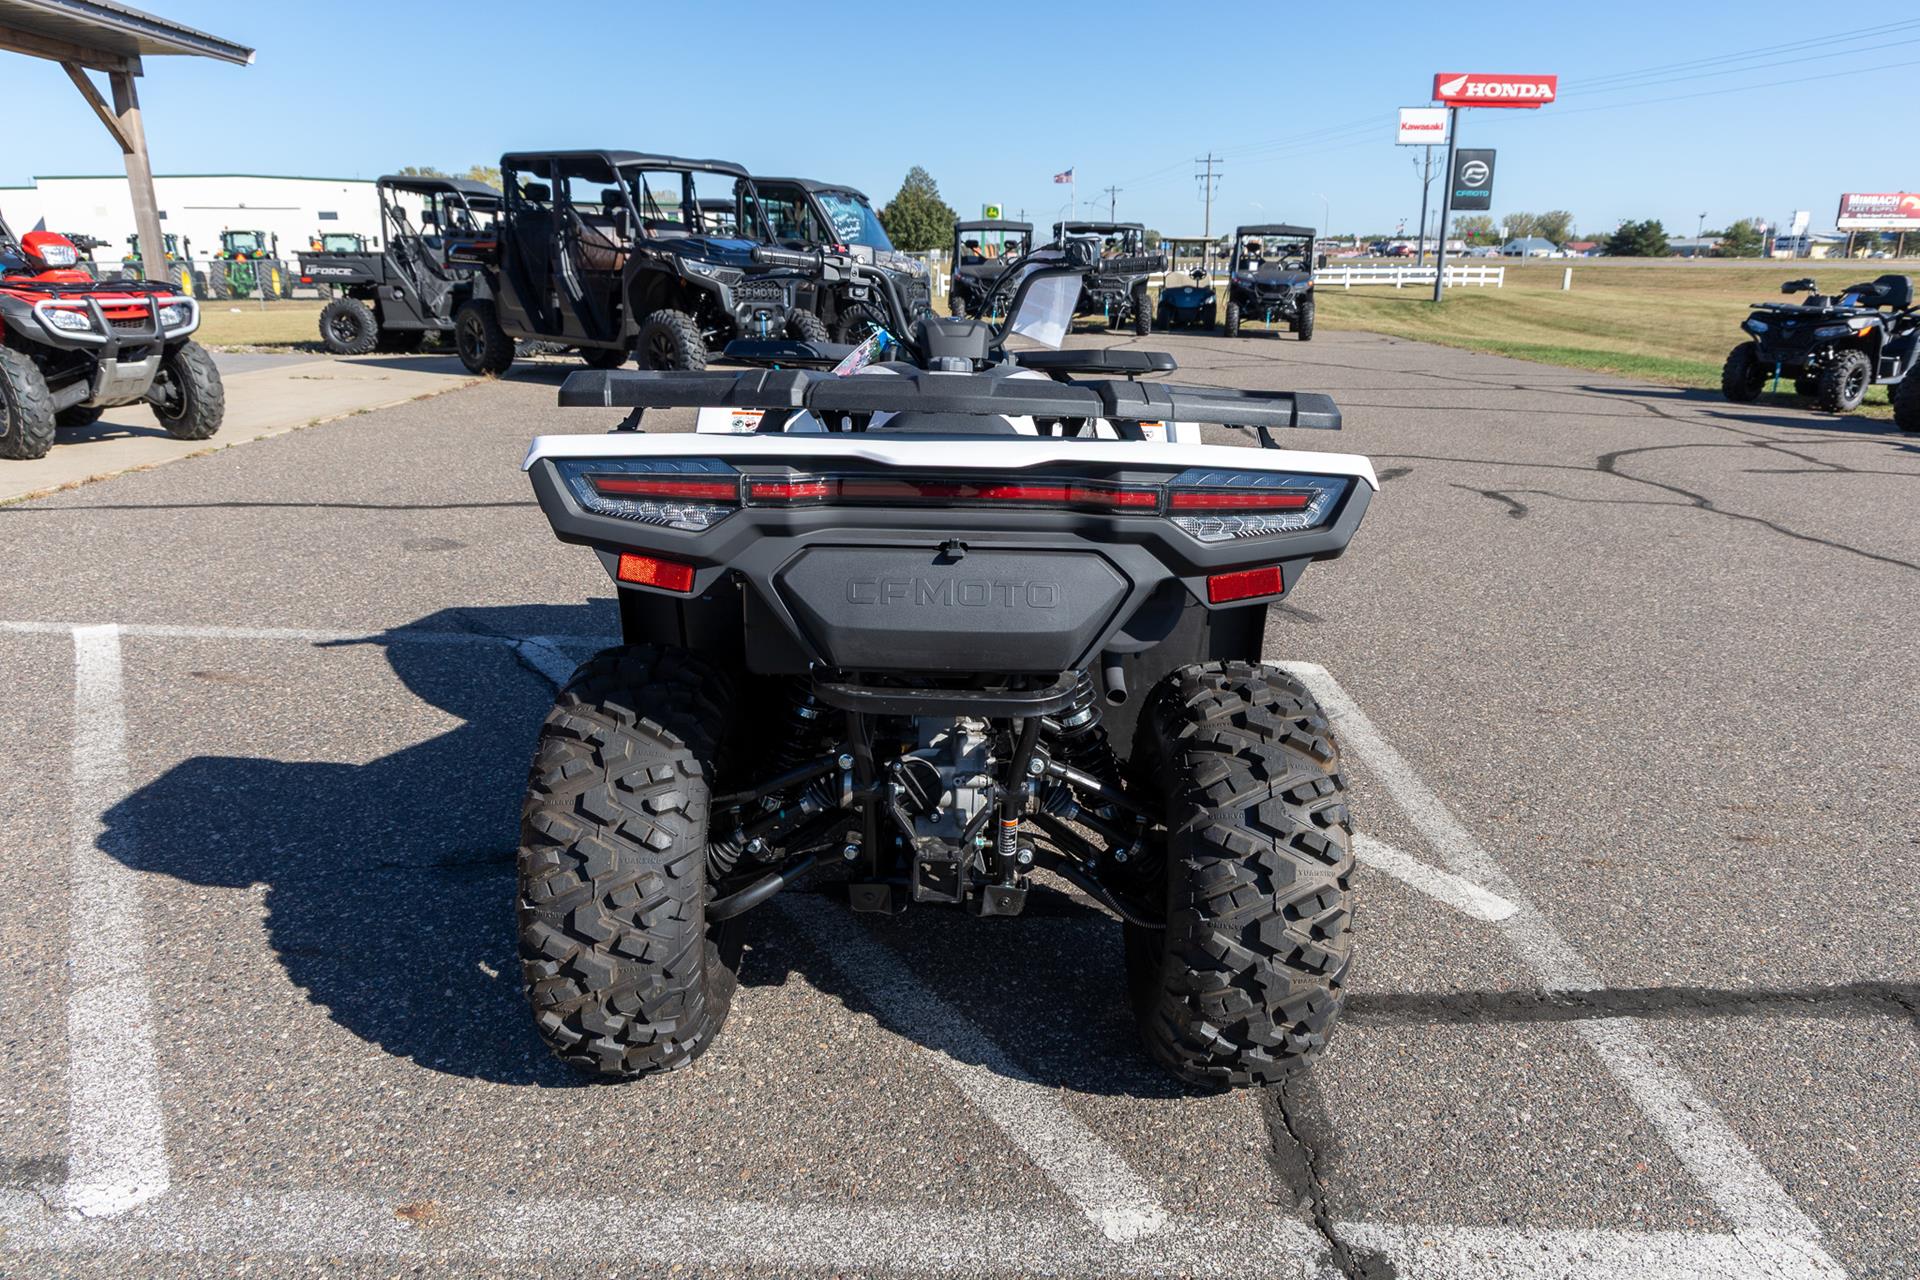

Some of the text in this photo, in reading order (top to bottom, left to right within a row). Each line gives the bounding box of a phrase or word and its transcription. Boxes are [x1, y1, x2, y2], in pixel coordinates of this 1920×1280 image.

[1465, 82, 1554, 98] HONDA
[1401, 122, 1444, 131] Kawasaki
[1455, 189, 1489, 197] CFMOTO
[305, 267, 353, 276] UFORCE
[737, 287, 781, 298] CFMOTO
[846, 576, 1062, 609] CFMOTO
